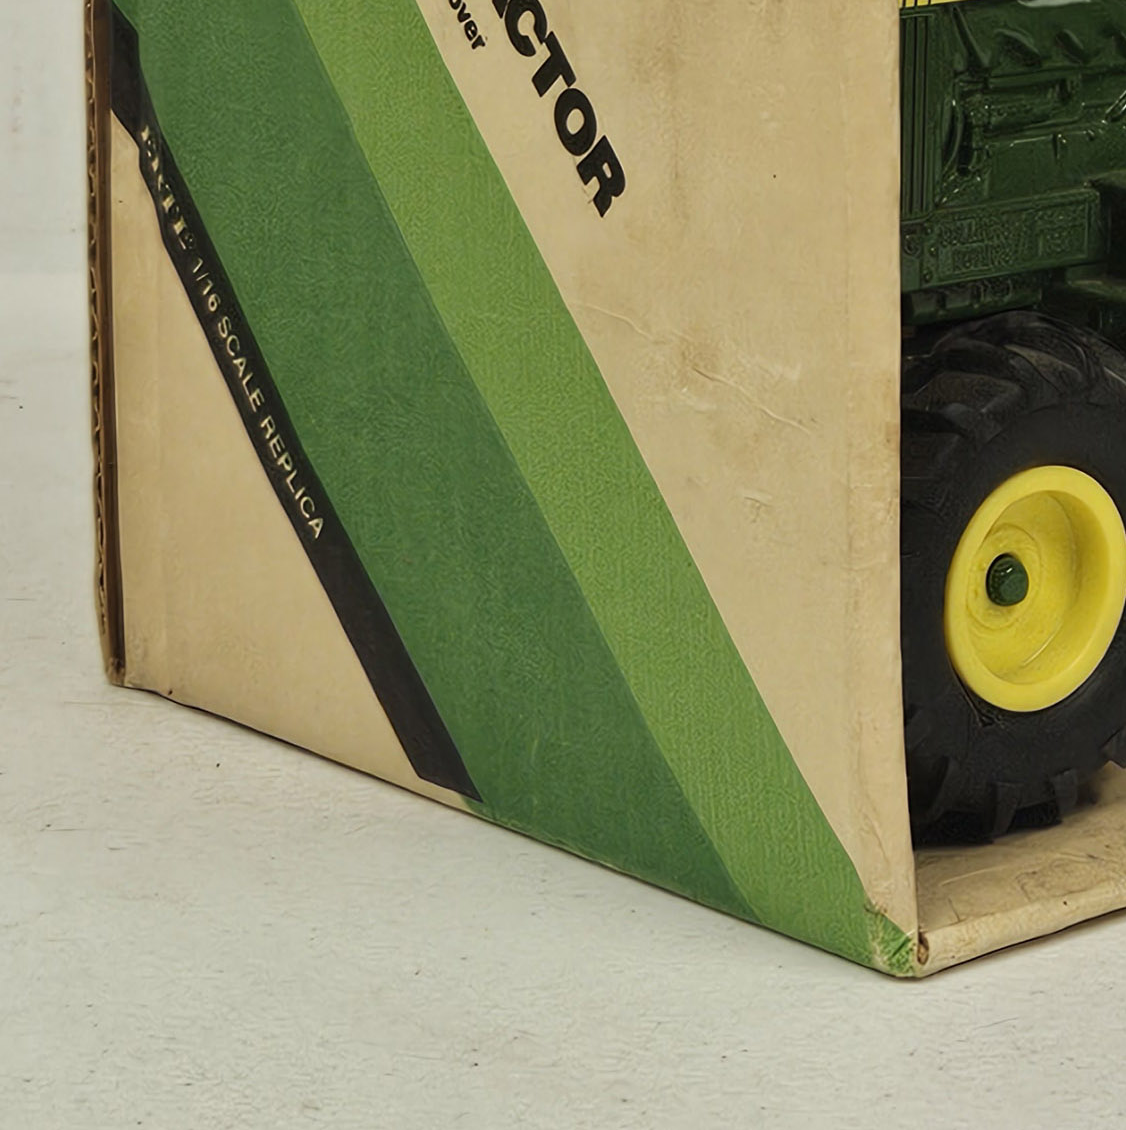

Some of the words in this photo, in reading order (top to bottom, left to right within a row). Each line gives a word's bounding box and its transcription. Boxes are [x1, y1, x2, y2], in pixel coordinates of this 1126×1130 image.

[192, 257, 221, 313] 1/16
[217, 316, 265, 413] SCALE
[260, 415, 325, 539] REPLICA
